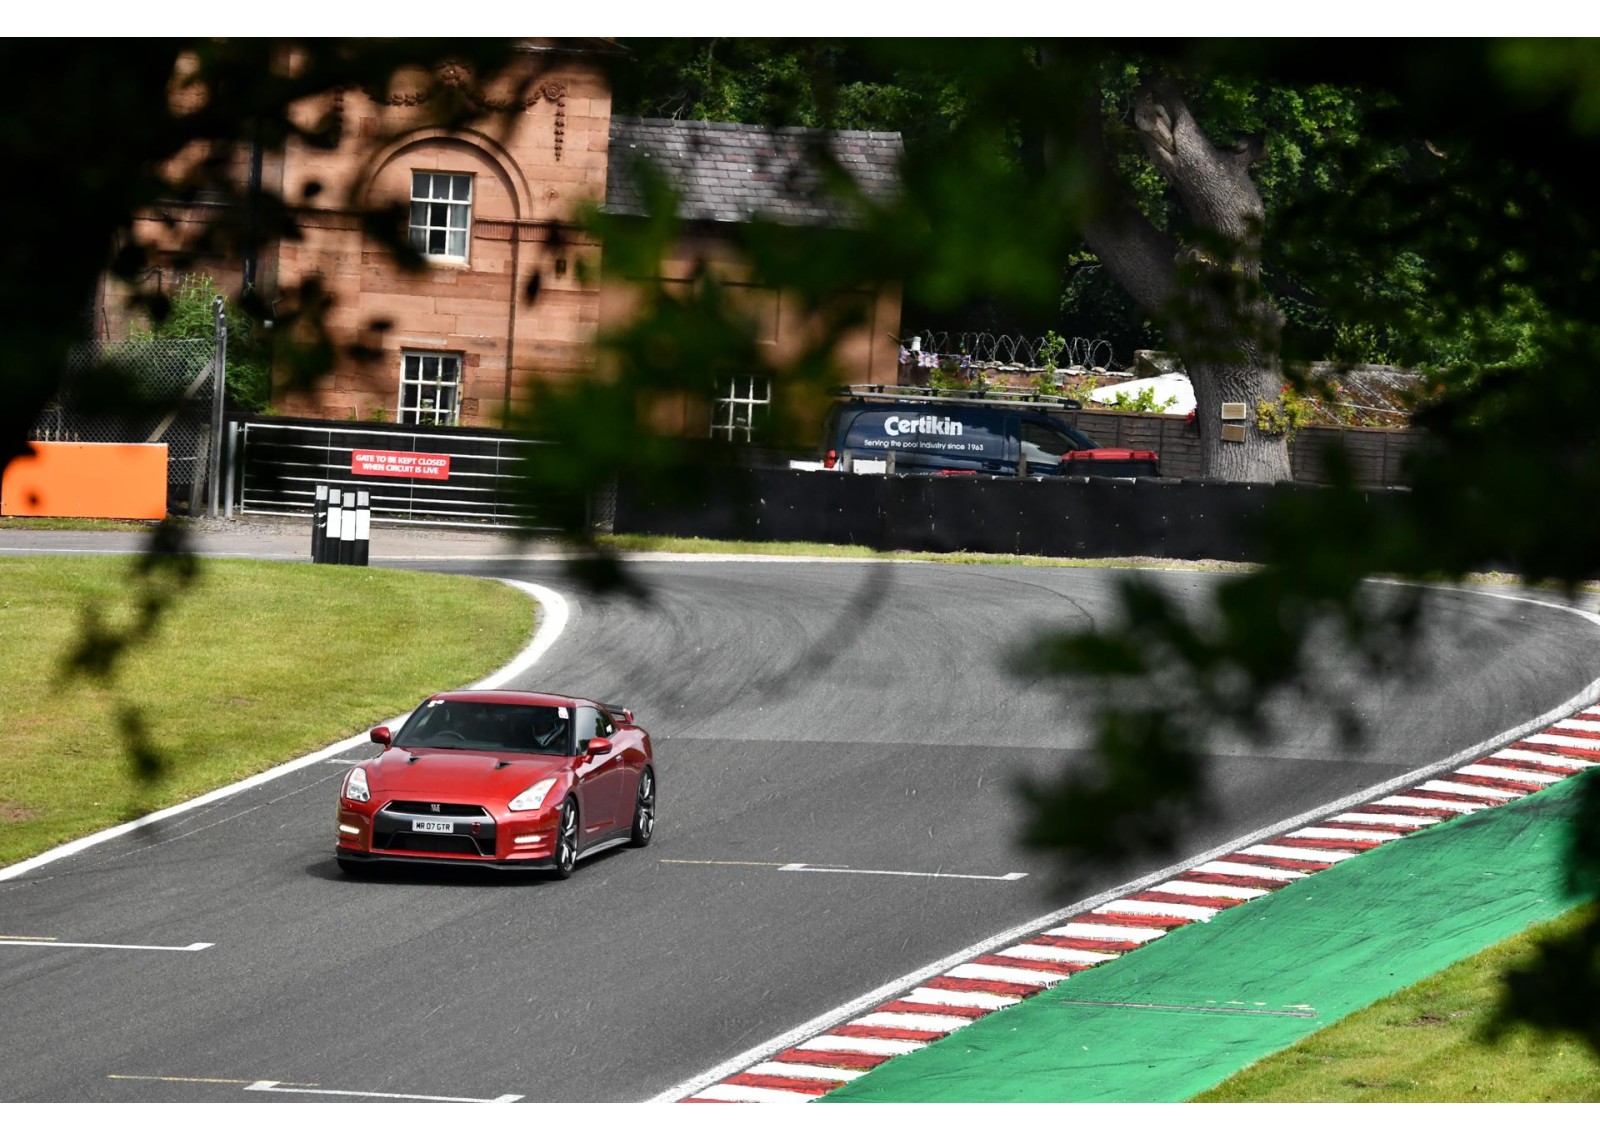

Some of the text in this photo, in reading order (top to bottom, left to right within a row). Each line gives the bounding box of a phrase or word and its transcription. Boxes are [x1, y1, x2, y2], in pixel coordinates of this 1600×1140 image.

[884, 415, 963, 436] Certikin
[864, 439, 890, 448] Serving
[890, 439, 902, 447] the
[902, 440, 918, 448] pool
[947, 442, 965, 450] since
[967, 443, 984, 451] 1963
[355, 454, 374, 462] GATE
[376, 455, 386, 463] TO
[398, 456, 417, 465] KEPT
[418, 458, 446, 467] CLOSED
[362, 463, 439, 474] WHEN CIRCUIT IS LIVE
[416, 822, 451, 831] MR 07 GTR
